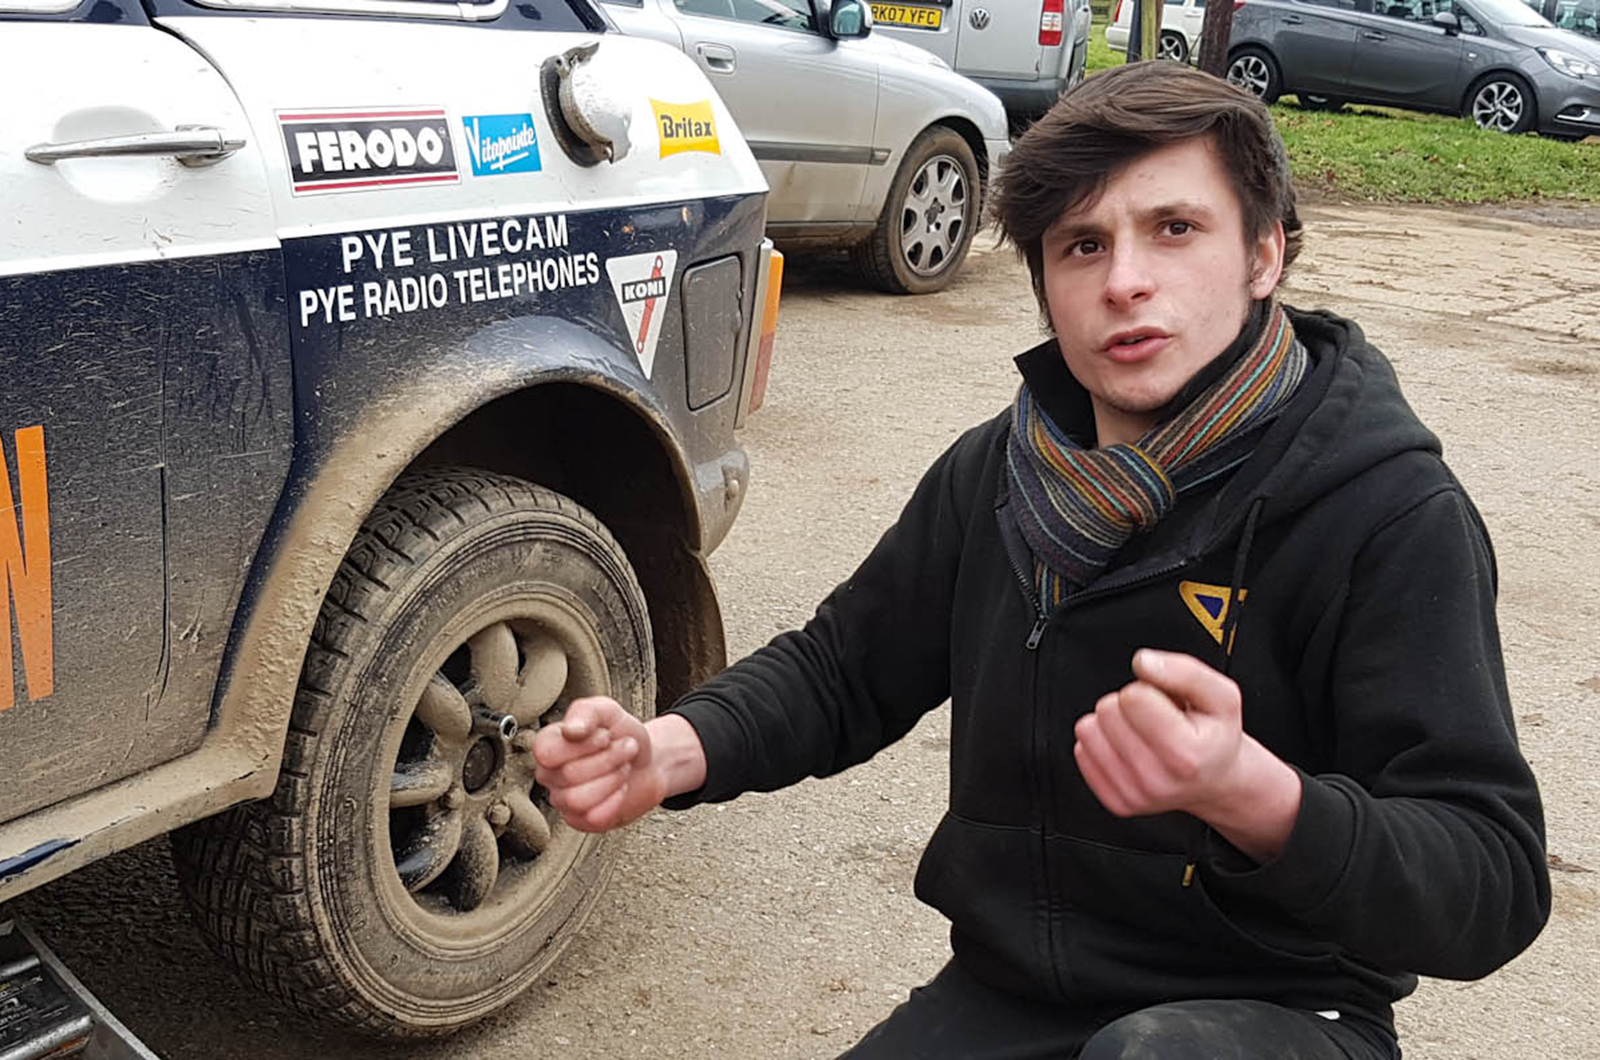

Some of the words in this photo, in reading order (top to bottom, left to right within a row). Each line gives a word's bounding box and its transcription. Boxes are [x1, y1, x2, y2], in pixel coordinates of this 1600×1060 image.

[871, 6, 906, 22] RK07
[910, 9, 936, 25] YFC
[465, 118, 536, 170] Vitapointe
[660, 114, 712, 138] Britax
[295, 127, 444, 173] FERODO
[341, 230, 414, 273] PYE
[427, 215, 569, 263] LIVECAM
[300, 285, 356, 327] PYE
[363, 273, 448, 317] RADIO
[454, 252, 600, 304] TELEPHONES
[624, 283, 664, 301] KONI
